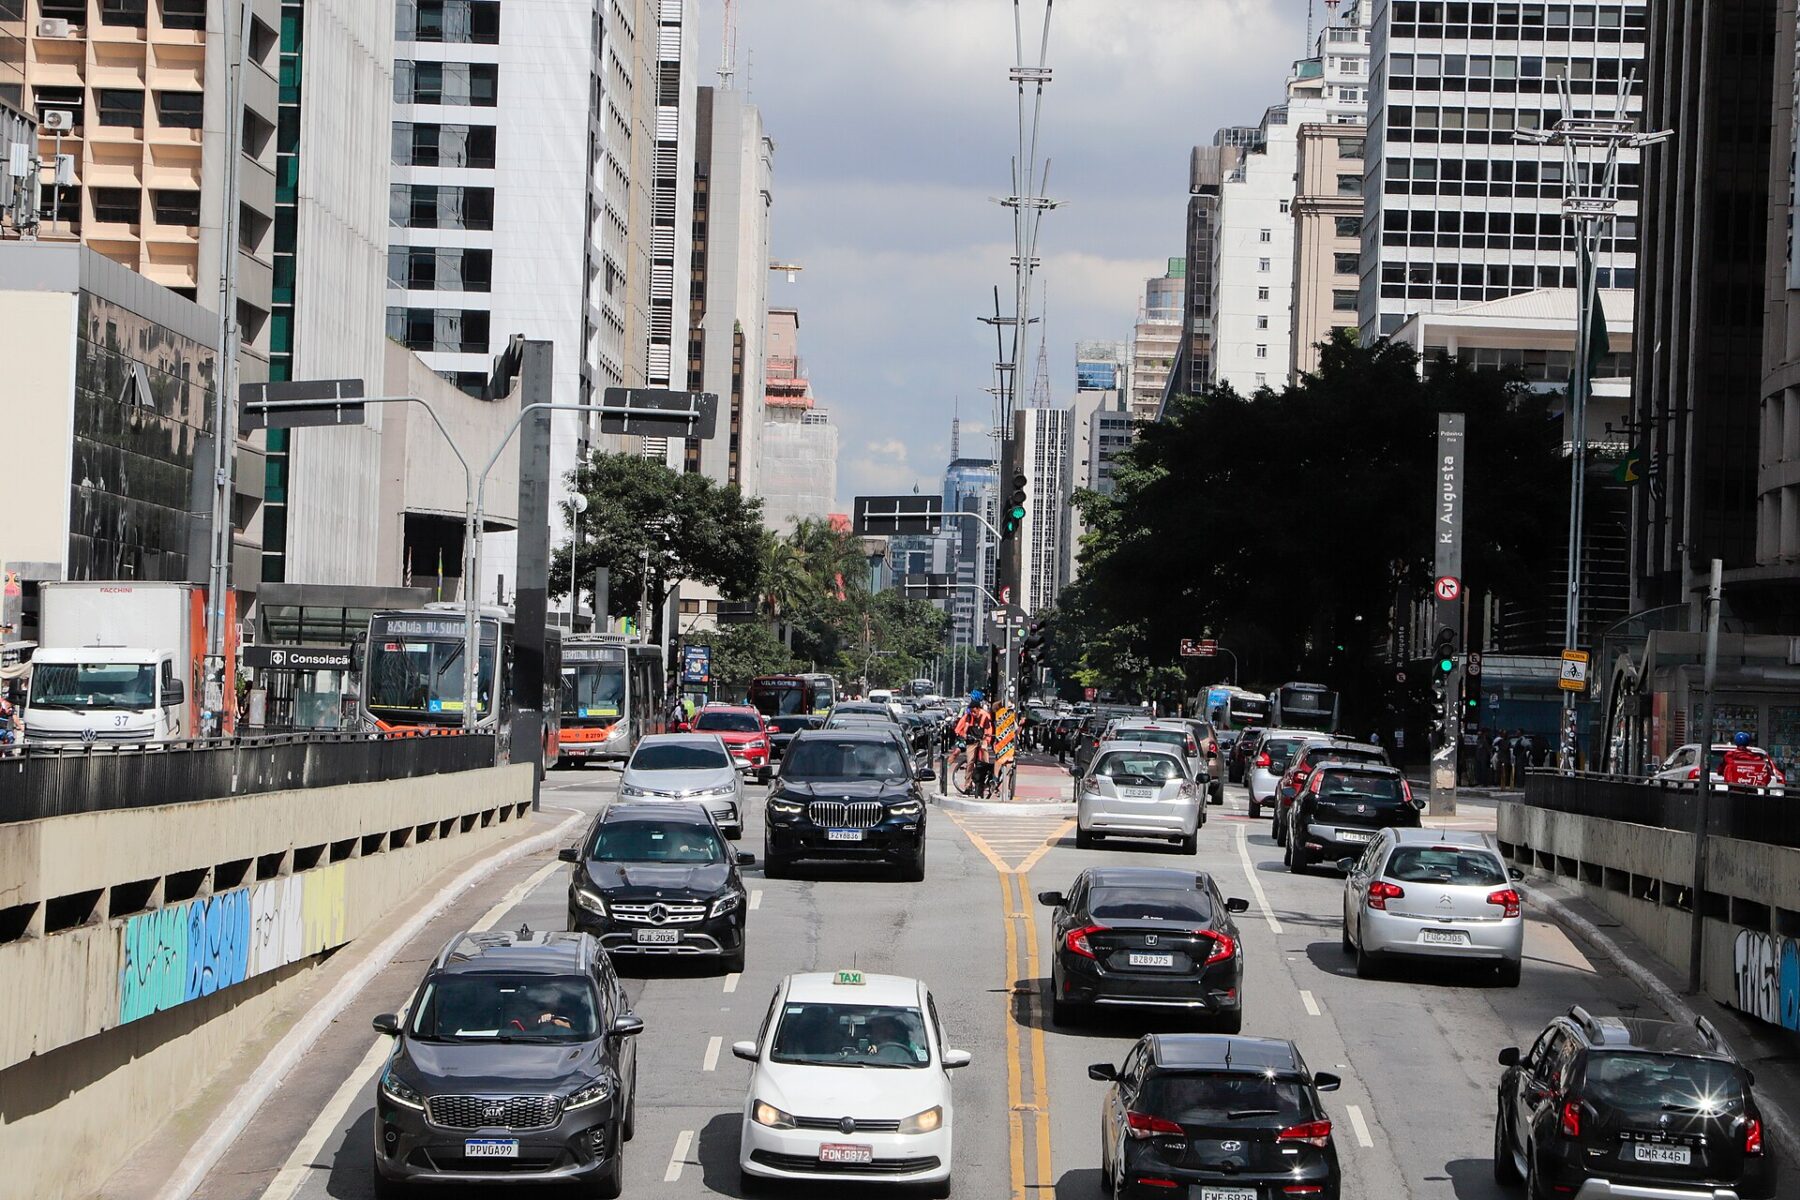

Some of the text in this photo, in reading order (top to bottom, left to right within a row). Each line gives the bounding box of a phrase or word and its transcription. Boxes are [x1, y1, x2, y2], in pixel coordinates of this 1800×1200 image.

[1440, 455, 1457, 525] Augusta
[114, 715, 130, 727] 37
[838, 972, 862, 983] TAXI
